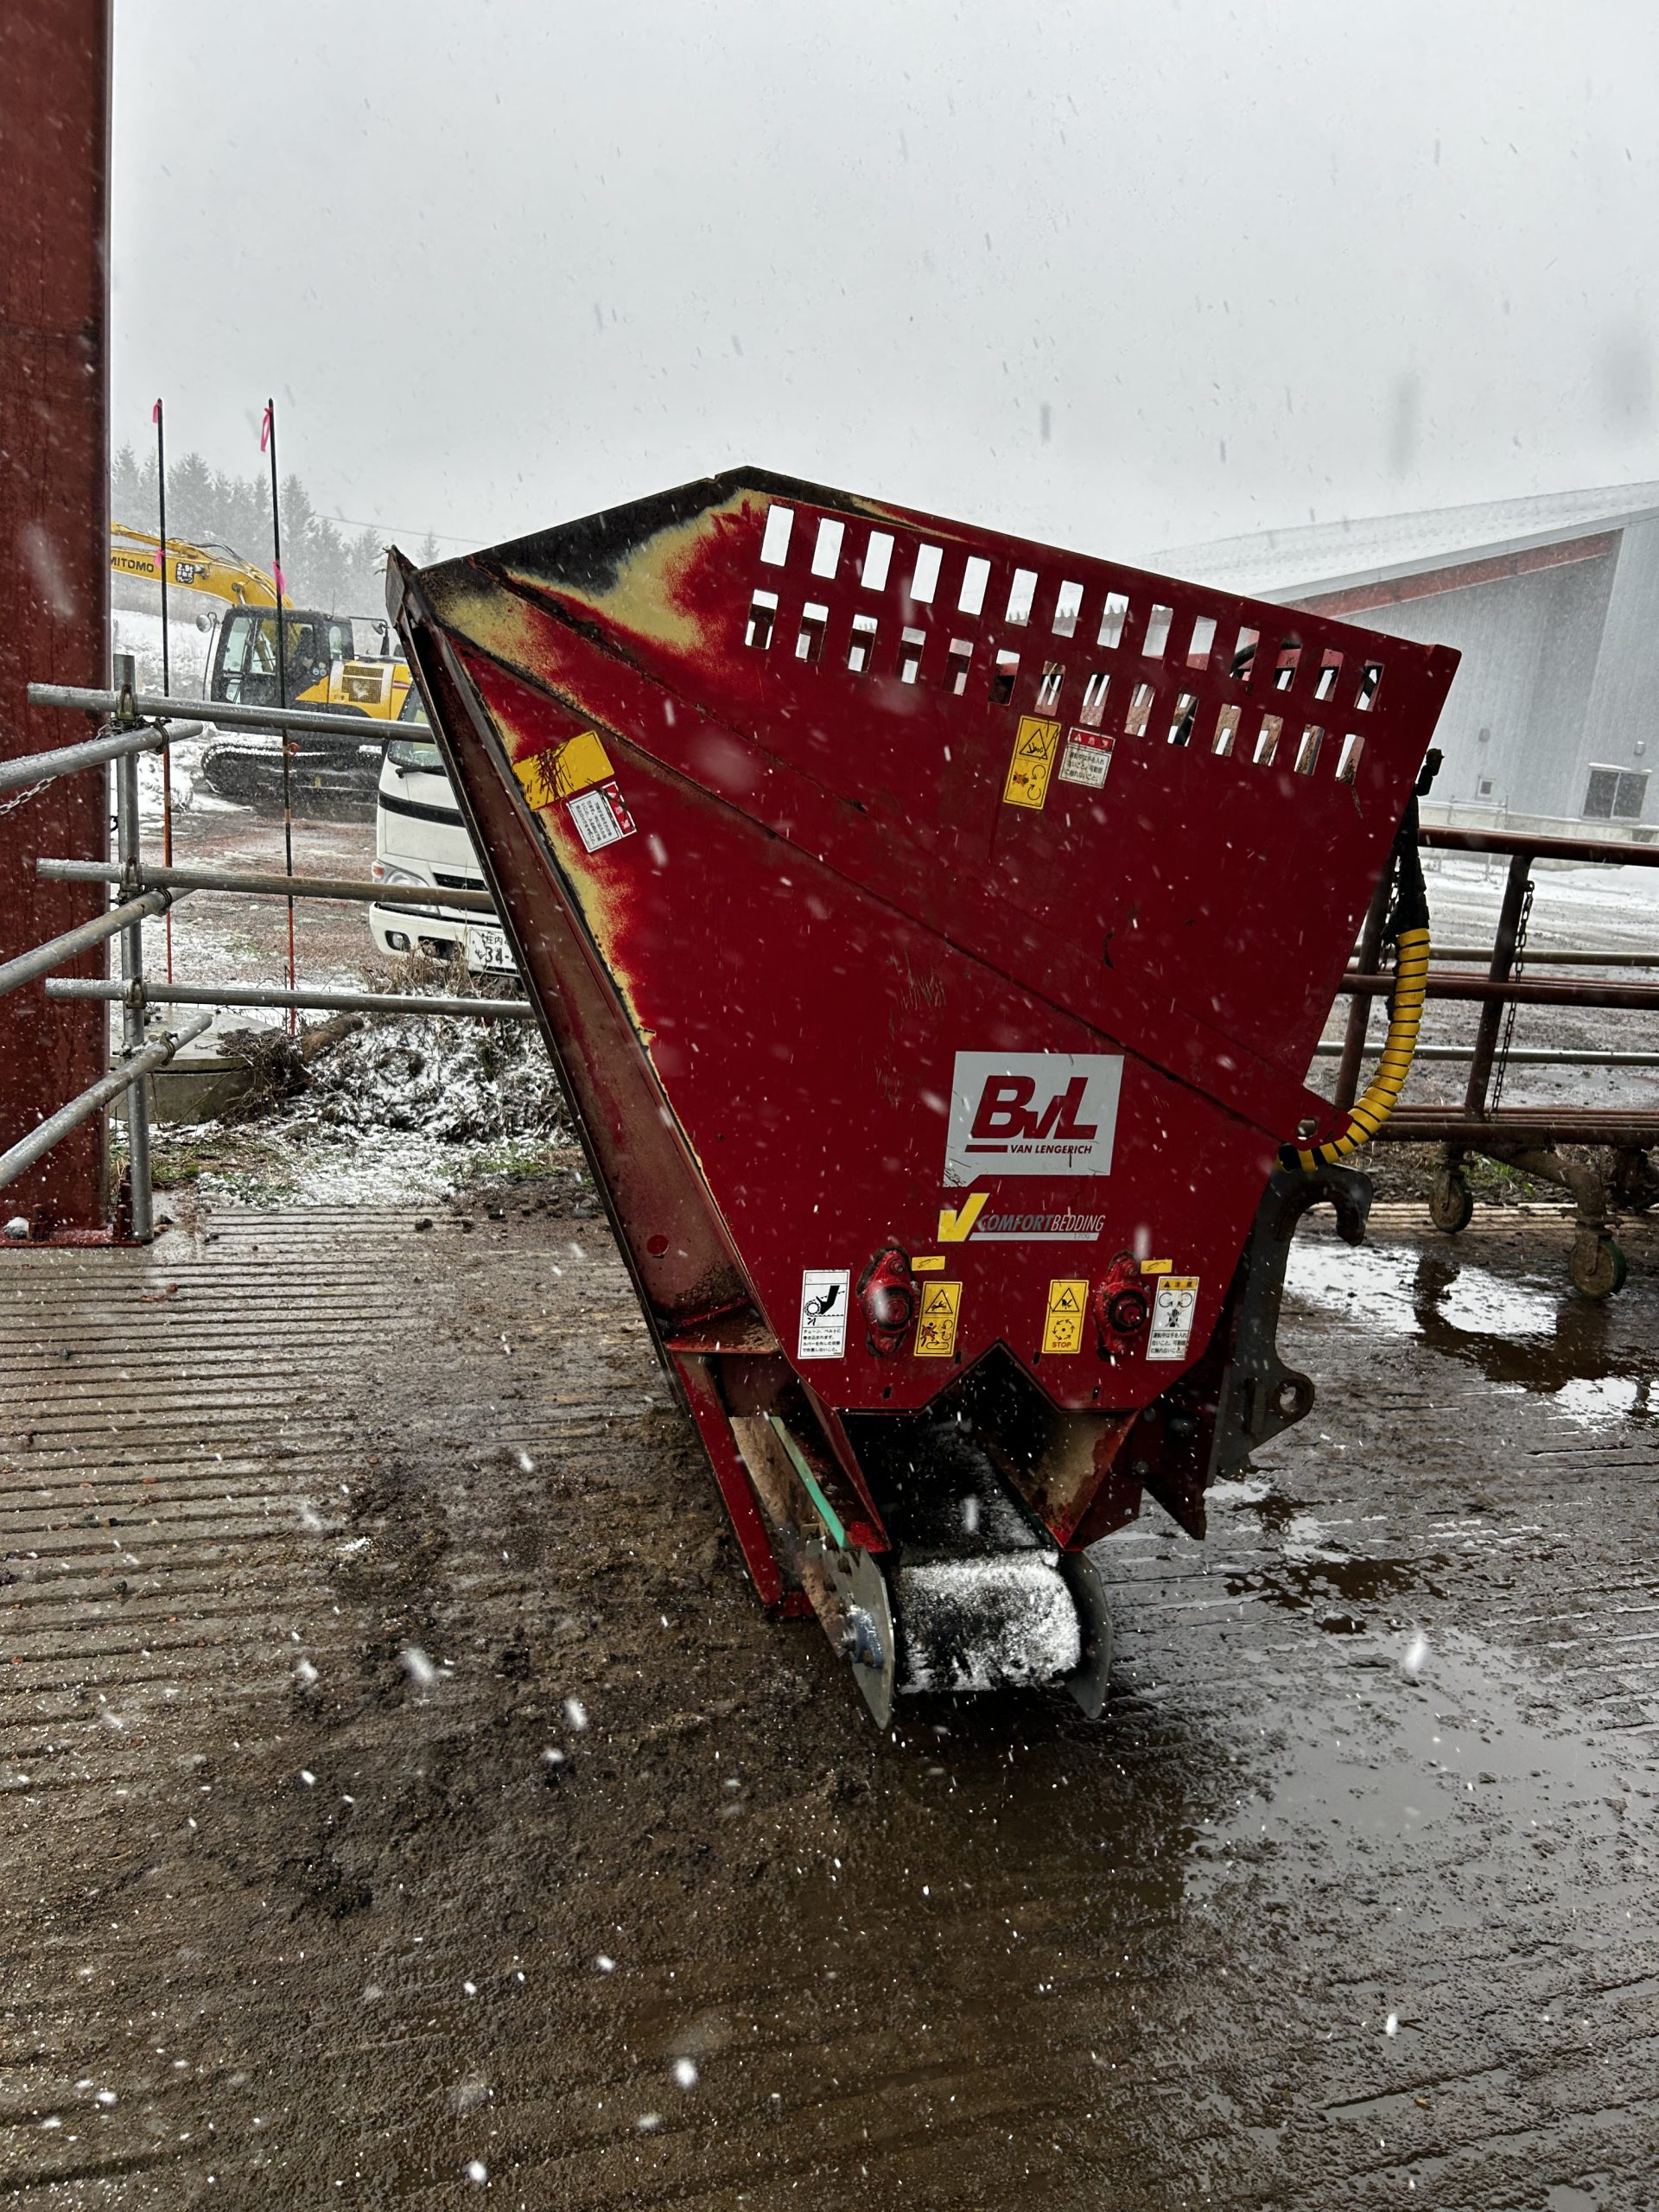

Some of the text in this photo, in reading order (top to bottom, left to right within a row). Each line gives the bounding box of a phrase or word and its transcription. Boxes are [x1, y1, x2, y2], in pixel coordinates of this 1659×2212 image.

[486, 946, 517, 964] 34-
[1010, 1144, 1092, 1155] VAN LENGERICH
